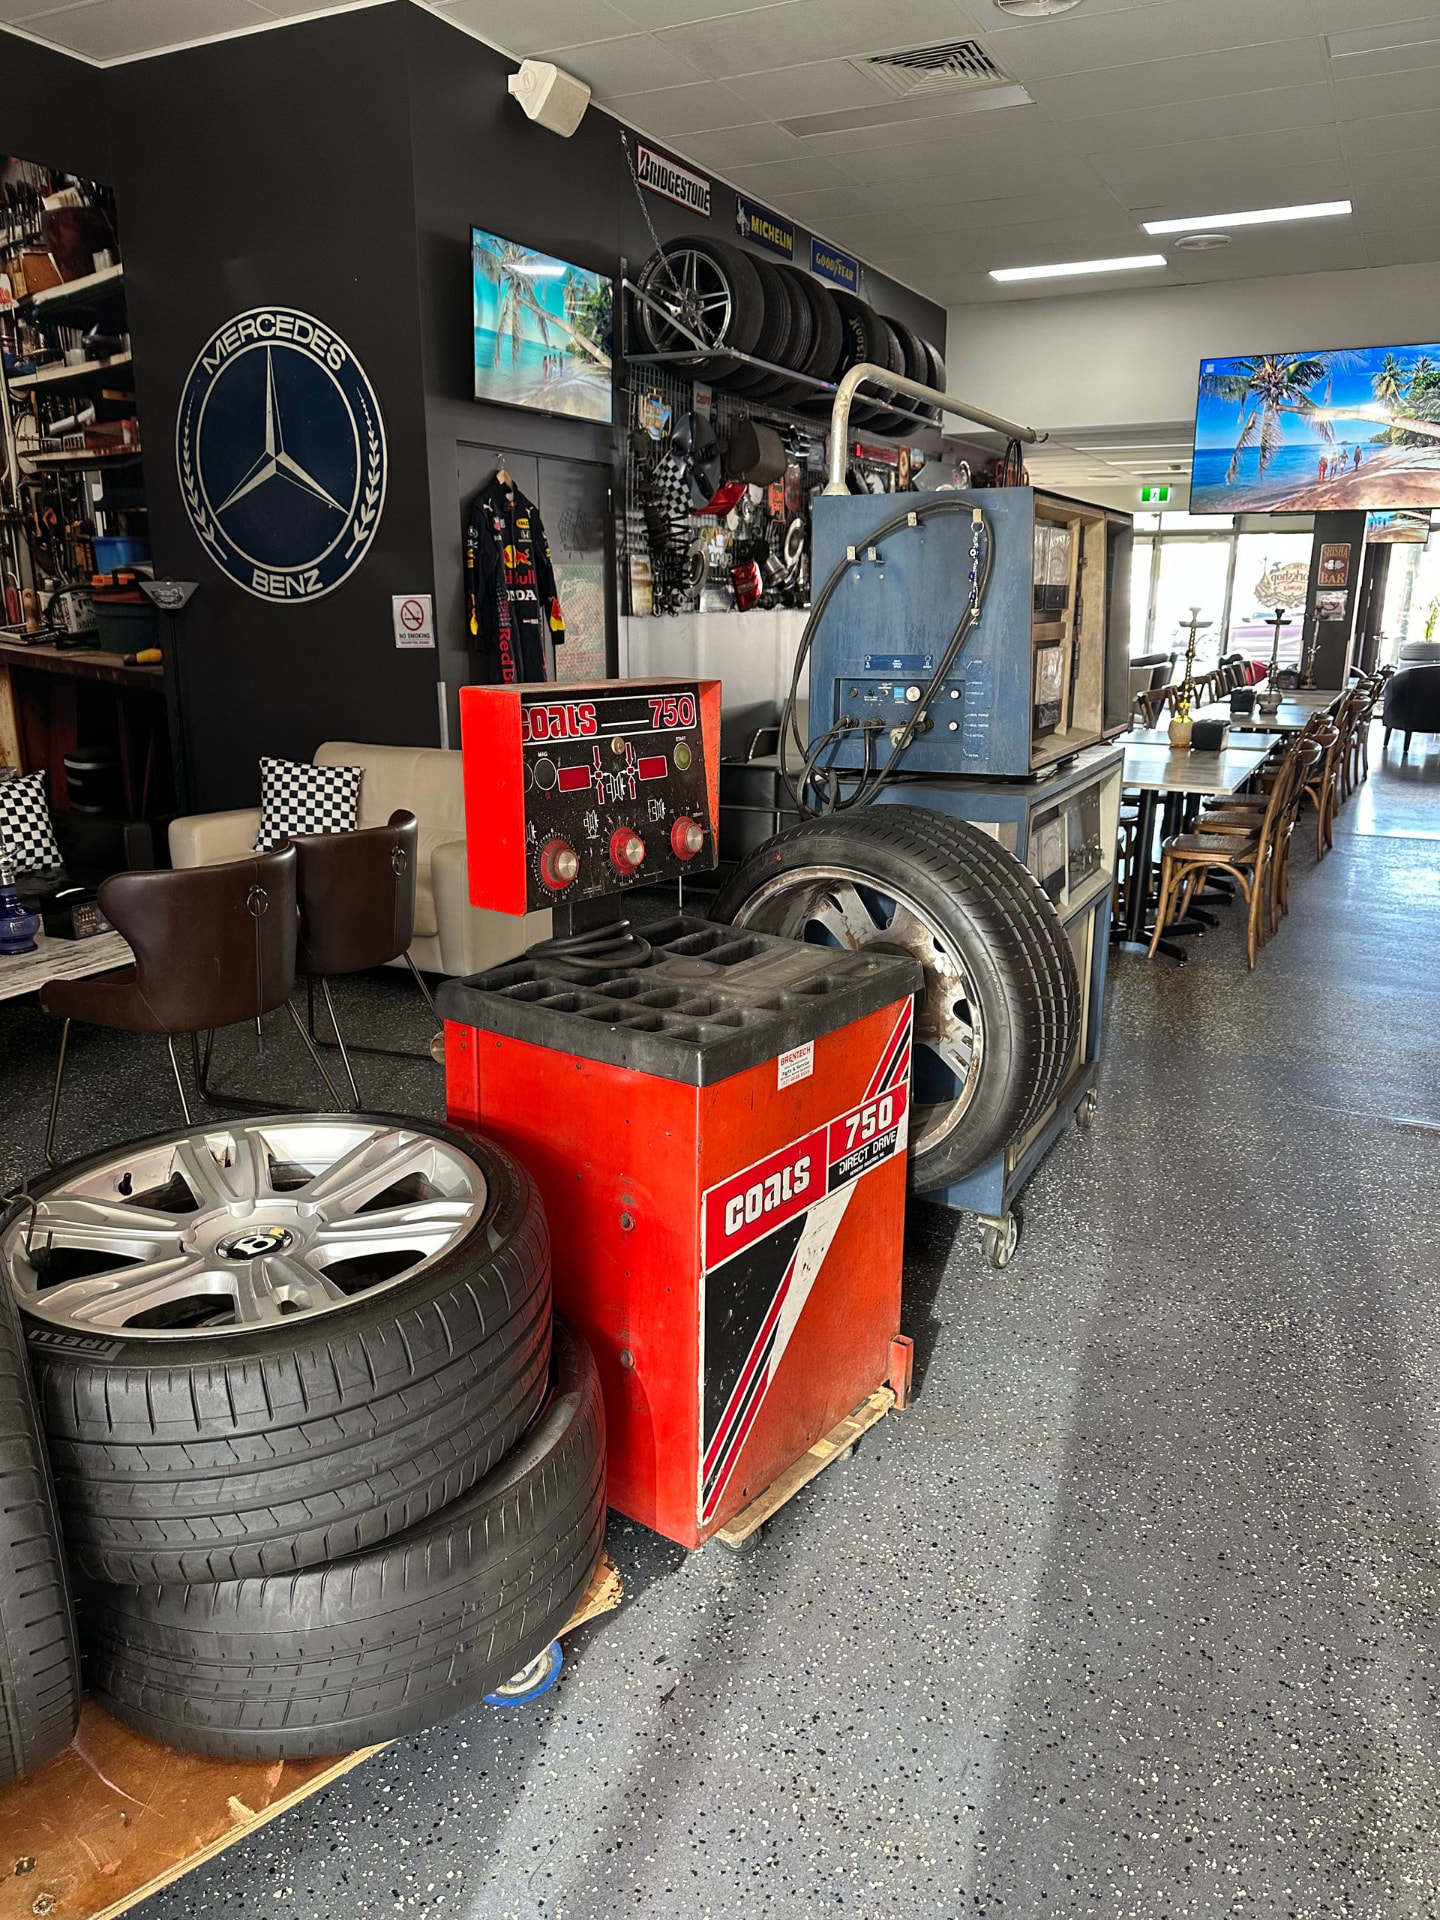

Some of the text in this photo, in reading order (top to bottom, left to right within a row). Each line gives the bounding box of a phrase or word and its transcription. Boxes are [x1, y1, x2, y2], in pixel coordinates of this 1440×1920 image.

[638, 150, 710, 212] BRIDGESTONE
[751, 215, 793, 251] MICHELIN
[815, 252, 853, 281] GOODYEAR
[201, 313, 346, 375] MERCEDES
[1323, 545, 1348, 559] SHISHA
[252, 568, 324, 596] BENZ
[1320, 572, 1345, 584] BAR
[499, 628, 514, 665] Red
[648, 696, 694, 729] 750
[781, 1046, 811, 1066] BRENTECH
[845, 1095, 893, 1151] 750
[839, 1130, 897, 1175] DIRECT DRIVE
